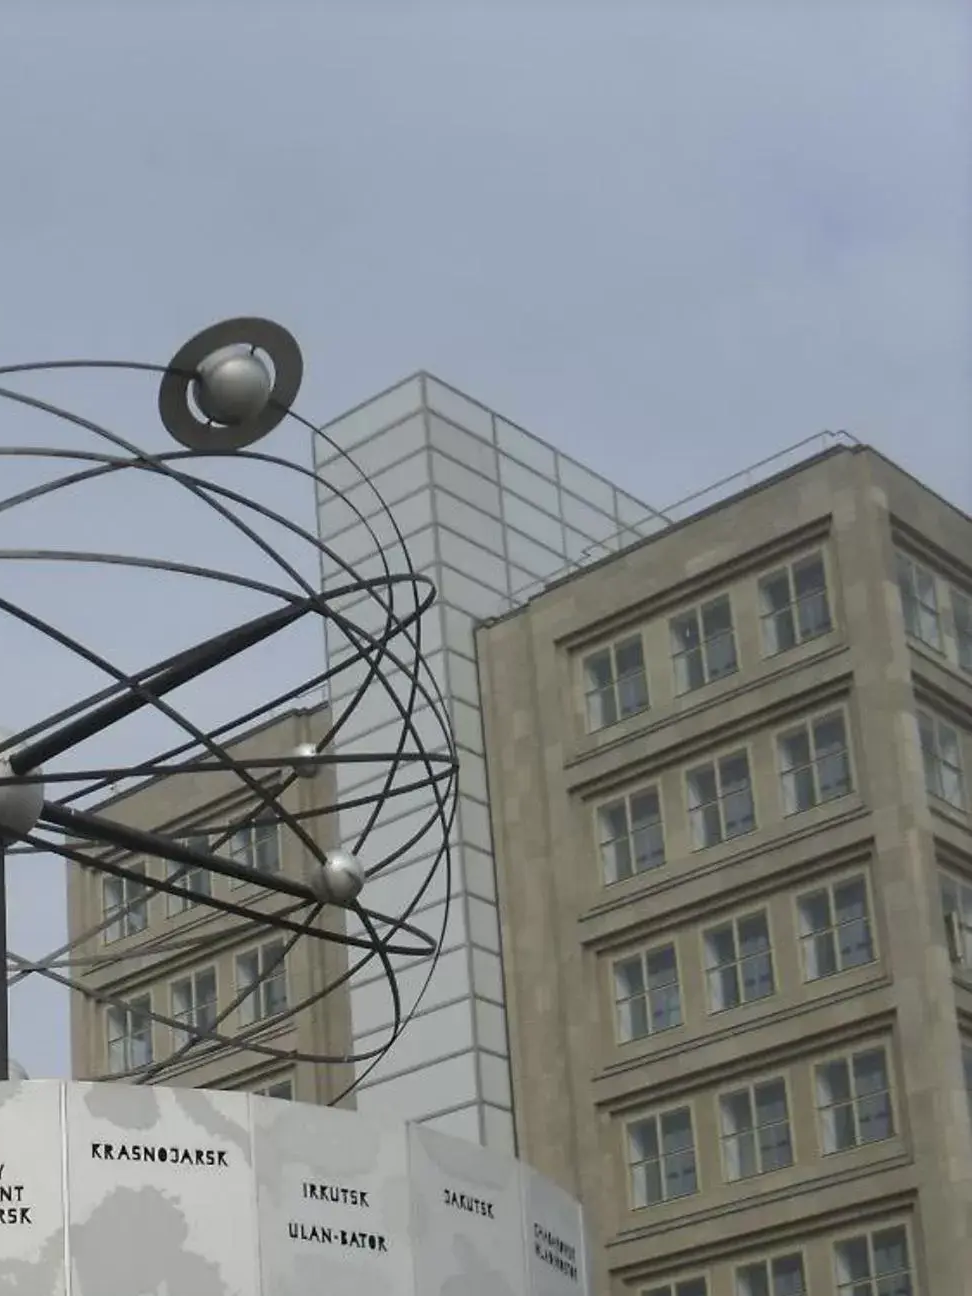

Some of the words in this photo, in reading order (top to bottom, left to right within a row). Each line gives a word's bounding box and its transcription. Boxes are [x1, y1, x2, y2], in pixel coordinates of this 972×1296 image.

[91, 1143, 229, 1167] KRASNOJARSK
[302, 1182, 370, 1207] IRKUTSK
[444, 1188, 495, 1220] JAKUTSK
[288, 1222, 388, 1252] ULAN-BATOR
